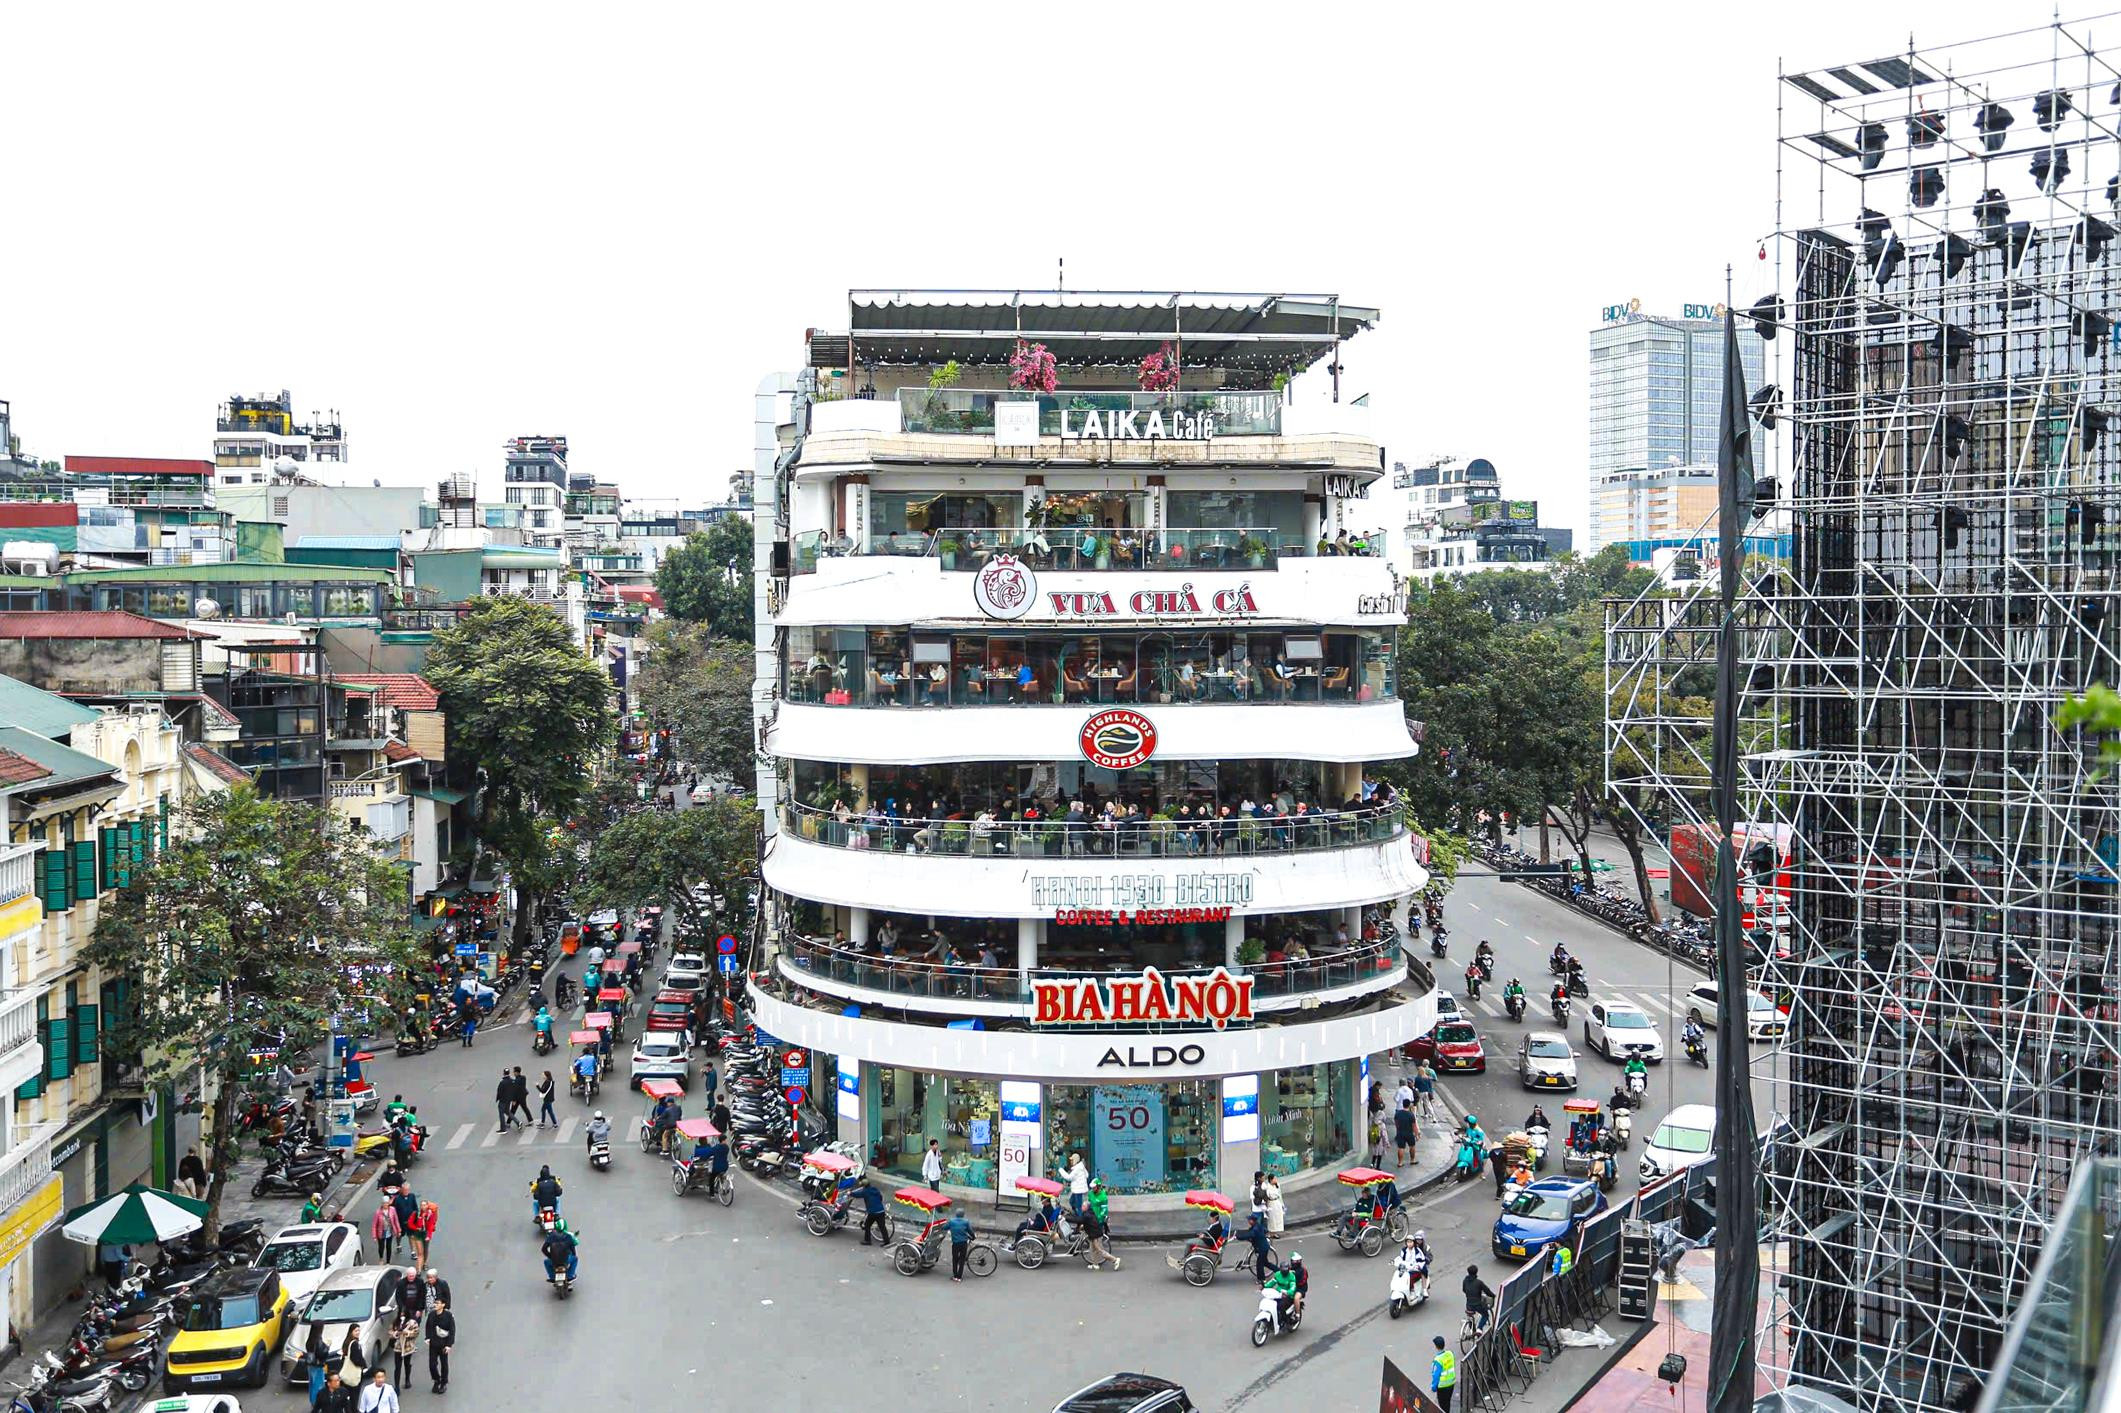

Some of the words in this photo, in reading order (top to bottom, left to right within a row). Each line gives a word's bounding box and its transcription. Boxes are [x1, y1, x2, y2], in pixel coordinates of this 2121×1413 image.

[1602, 302, 1630, 321] BIDV
[1683, 303, 1714, 319] BIDV
[1061, 410, 1167, 439] LAIKA
[1172, 410, 1214, 440] Café
[1325, 475, 1361, 498] LAIKA
[1048, 591, 1118, 615] VUA
[1129, 583, 1202, 614] CHẢ
[1212, 583, 1259, 614] CÁ
[1084, 713, 1154, 738] HIGHLANDS
[1092, 751, 1146, 767] COFFEE
[1031, 876, 1102, 906] HANOI
[1111, 874, 1166, 905] 1930
[1176, 873, 1254, 905] BISTRO
[1055, 909, 1113, 926] COFFEE
[1118, 909, 1130, 926] &
[1135, 906, 1233, 925] RESTAURANT
[1034, 984, 1106, 1022] BIA
[1110, 971, 1171, 1020] HÀ
[1176, 971, 1253, 1029] NỘI
[1096, 1044, 1206, 1068] ALDO
[1107, 1106, 1150, 1131] 50
[1003, 1148, 1025, 1164] 50
